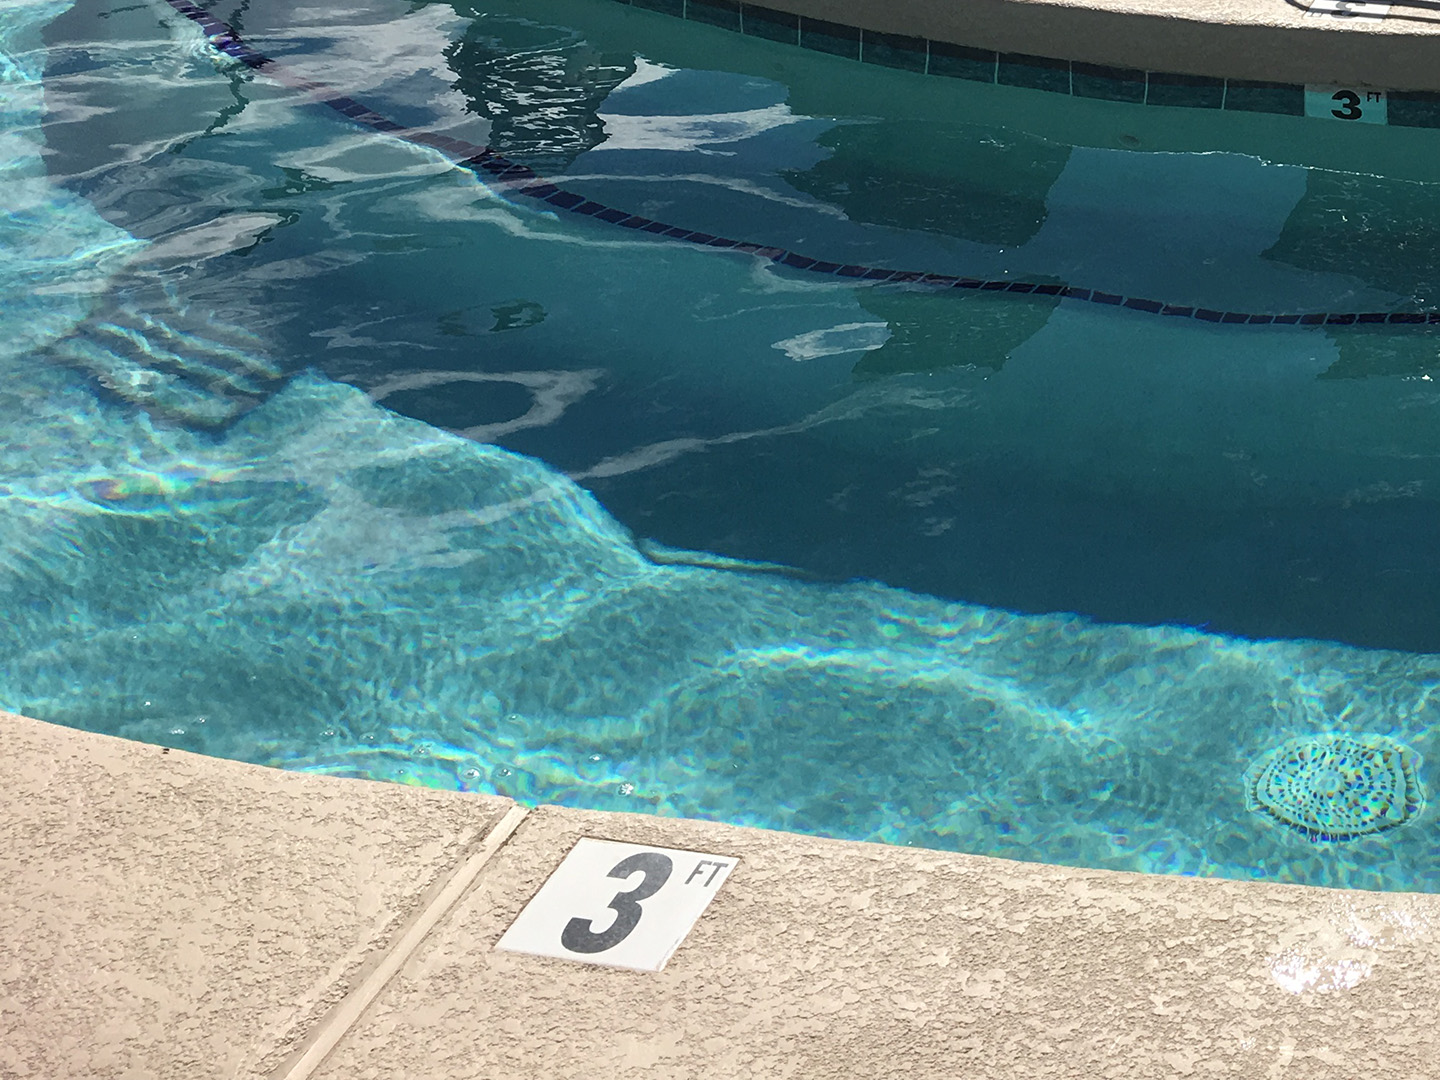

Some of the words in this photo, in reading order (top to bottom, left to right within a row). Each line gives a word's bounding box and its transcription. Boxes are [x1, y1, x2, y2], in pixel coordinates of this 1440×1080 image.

[1331, 89, 1363, 120] 3
[1366, 91, 1381, 103] FT
[561, 852, 673, 954] 3
[684, 860, 729, 888] FT
